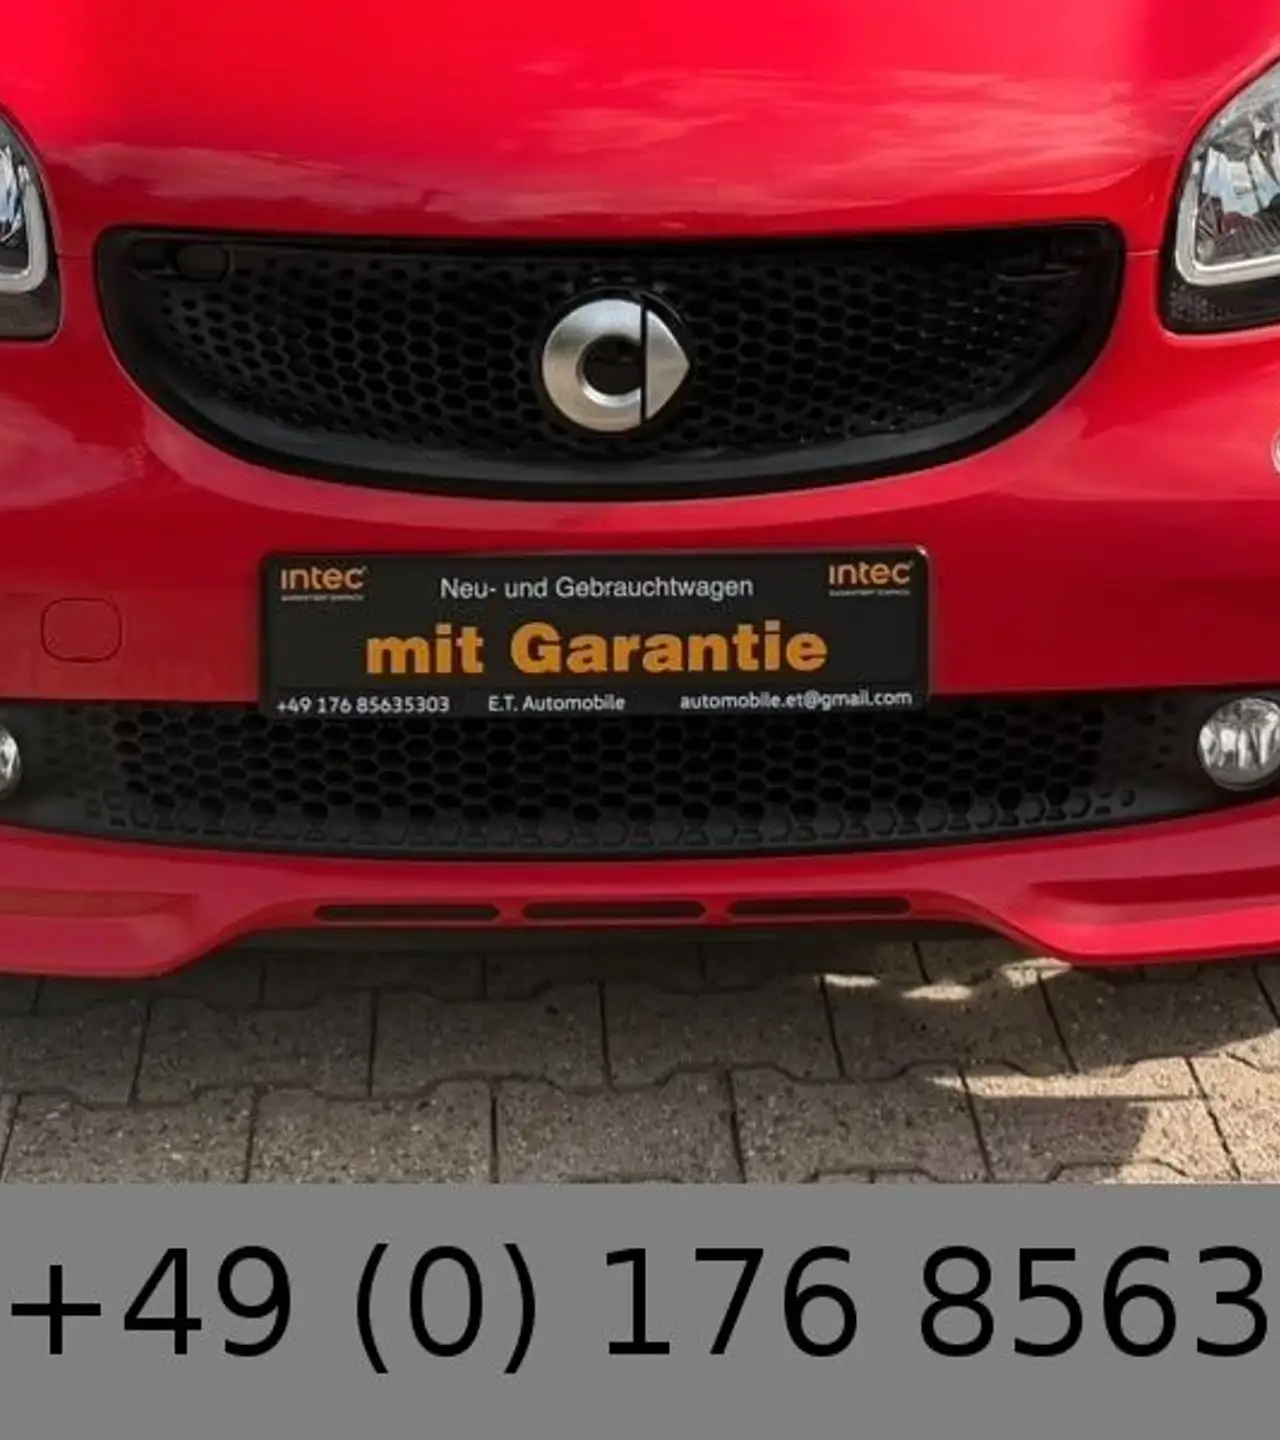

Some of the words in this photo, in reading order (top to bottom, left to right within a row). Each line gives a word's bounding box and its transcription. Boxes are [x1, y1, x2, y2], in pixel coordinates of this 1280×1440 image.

[280, 565, 365, 590] intec
[829, 561, 910, 585] intec
[440, 577, 497, 599] Neu-
[504, 576, 548, 599] und
[555, 575, 754, 601] Gebrauchtwagen
[366, 623, 484, 674] mit
[510, 620, 828, 674] Garantie
[276, 696, 312, 714] +49
[317, 696, 352, 713] 176
[355, 696, 450, 714] 85635303
[488, 695, 518, 711] E.T.
[522, 693, 626, 712] Automobile
[680, 689, 913, 711] automobile.et@gmail.com
